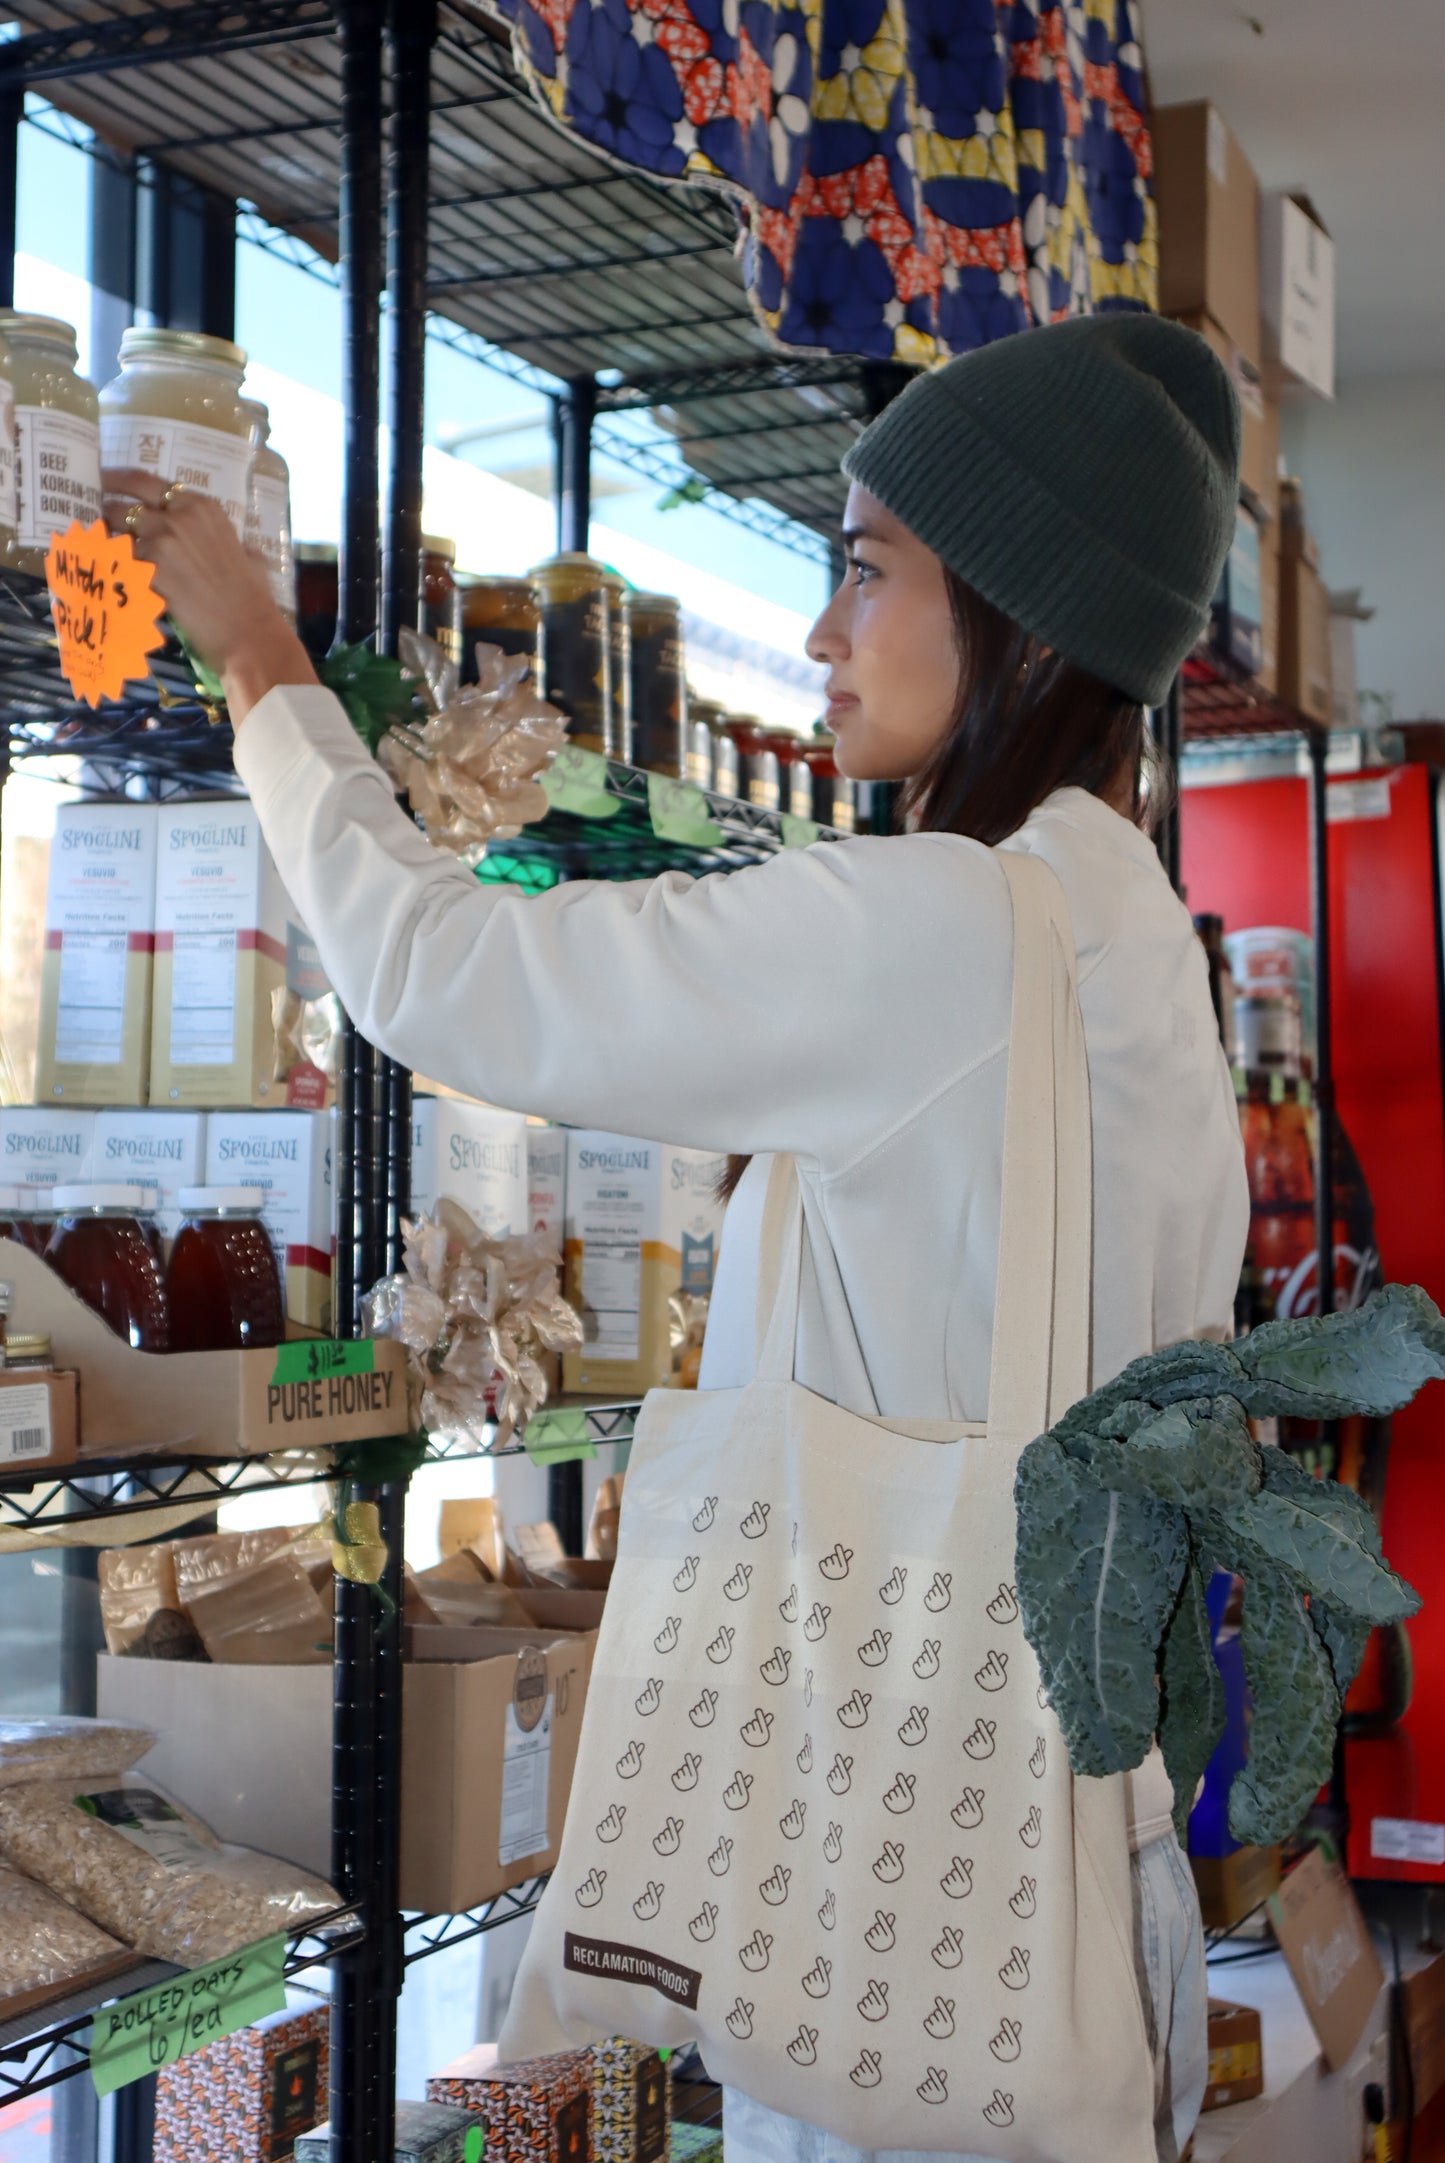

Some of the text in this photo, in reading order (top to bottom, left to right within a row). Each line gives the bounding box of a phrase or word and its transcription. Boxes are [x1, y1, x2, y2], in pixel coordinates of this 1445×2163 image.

[40, 451, 68, 472] BEEF
[175, 465, 210, 488] PORK
[40, 494, 72, 517] BONE
[56, 549, 128, 608] Mitch's
[61, 828, 142, 851] SFOGLINI
[169, 825, 247, 851] SFOGLINI
[5, 1132, 81, 1156] SFOGLINI
[105, 1136, 184, 1160] SFOGLINI
[218, 1138, 298, 1161] SFOGLINI
[449, 1133, 520, 1179] SFOGLINI
[578, 1150, 649, 1170] SFOGLINI
[267, 1370, 394, 1424] PURE HONEY
[573, 1945, 690, 1997] RECLAMATION FOODS
[109, 1958, 243, 2039] ROLLED OATS
